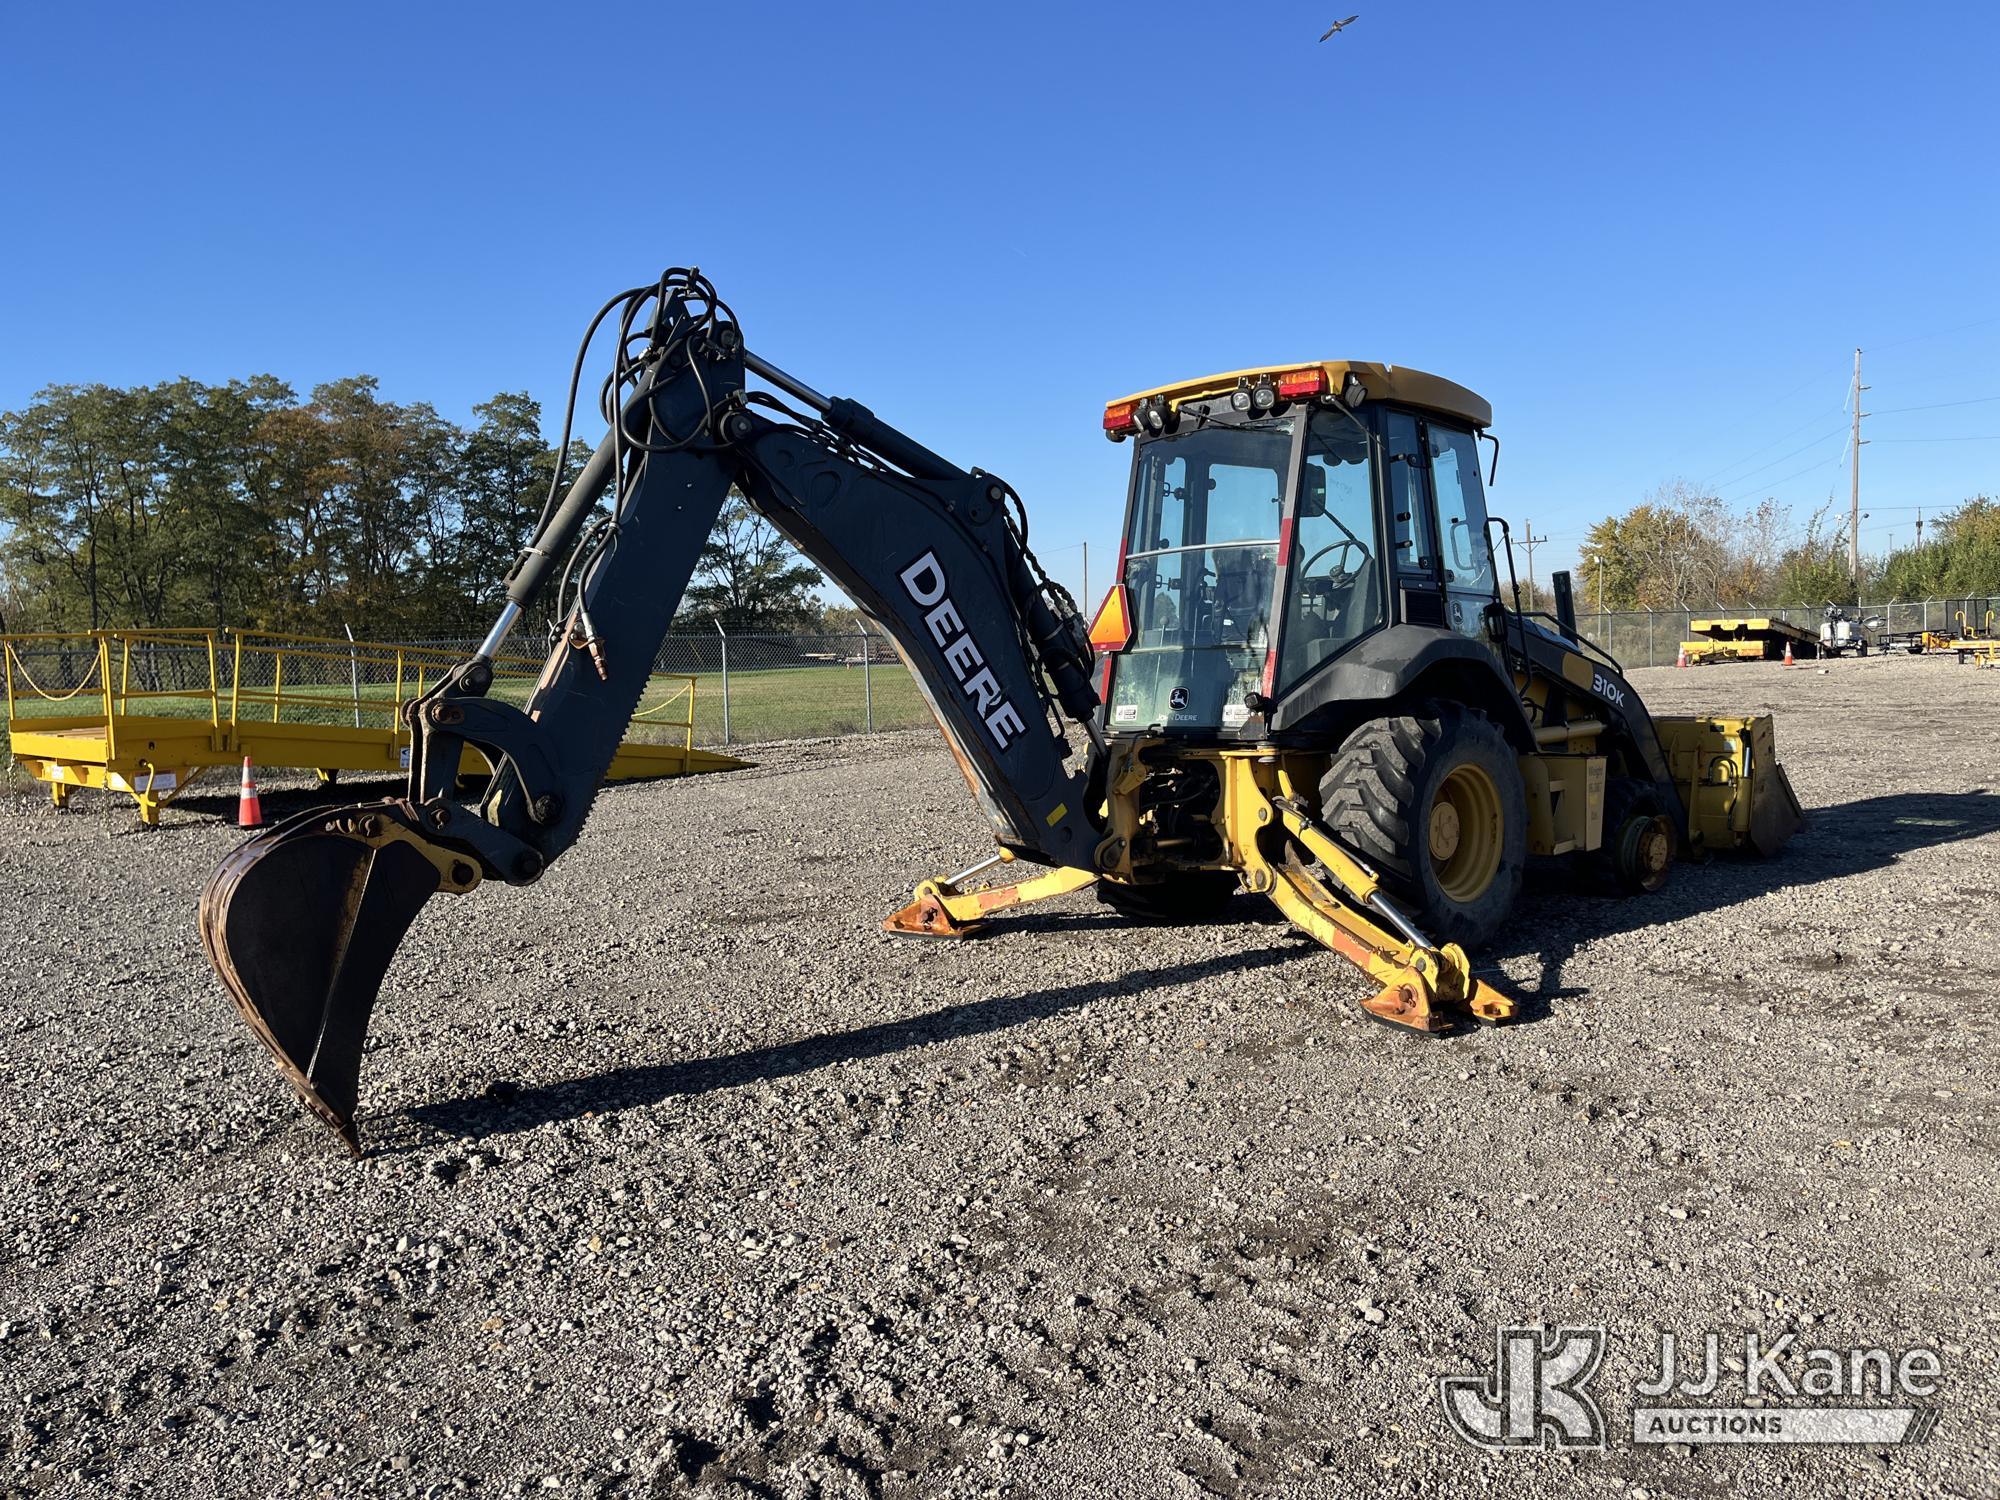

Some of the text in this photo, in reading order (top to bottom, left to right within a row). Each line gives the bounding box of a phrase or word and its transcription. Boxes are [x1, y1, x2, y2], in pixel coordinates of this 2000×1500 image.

[900, 550, 1027, 750] DEERE
[1593, 673, 1625, 708] 310K
[1174, 713, 1198, 721] DEERE
